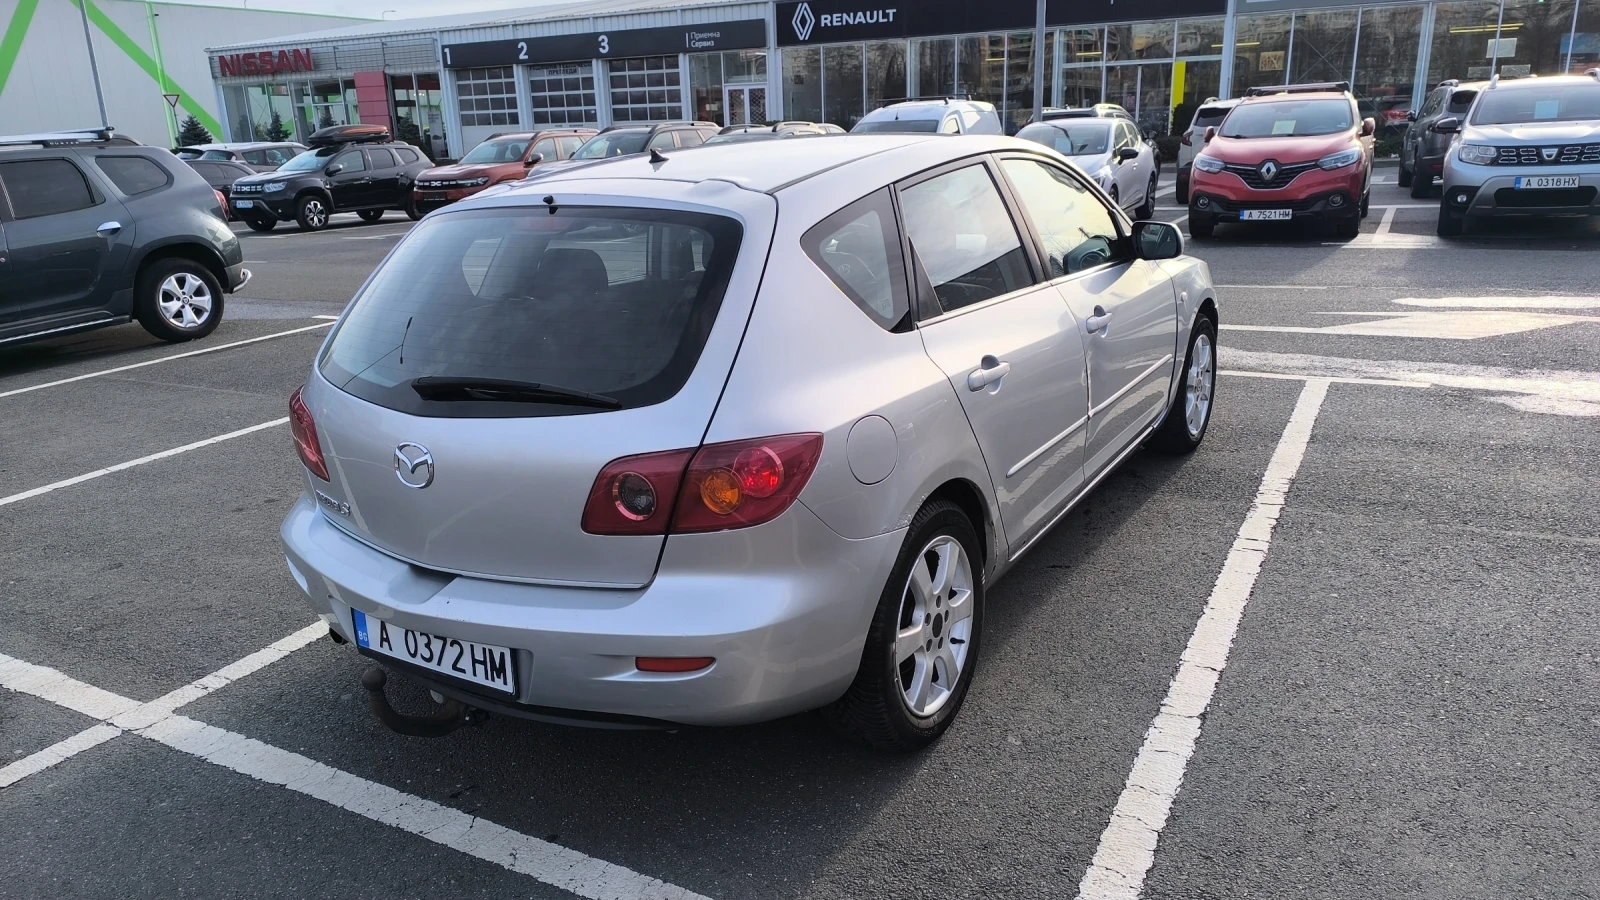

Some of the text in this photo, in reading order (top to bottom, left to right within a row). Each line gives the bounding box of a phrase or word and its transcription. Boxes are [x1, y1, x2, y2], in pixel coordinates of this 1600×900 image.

[820, 8, 897, 27] RENAULT
[598, 34, 610, 54] 3
[690, 31, 721, 40] Приемна
[690, 40, 715, 48] Сервиз
[443, 47, 451, 65] 1
[517, 41, 529, 60] 2
[218, 48, 314, 77] NISSAN
[358, 631, 369, 642] BG
[379, 620, 393, 652] A
